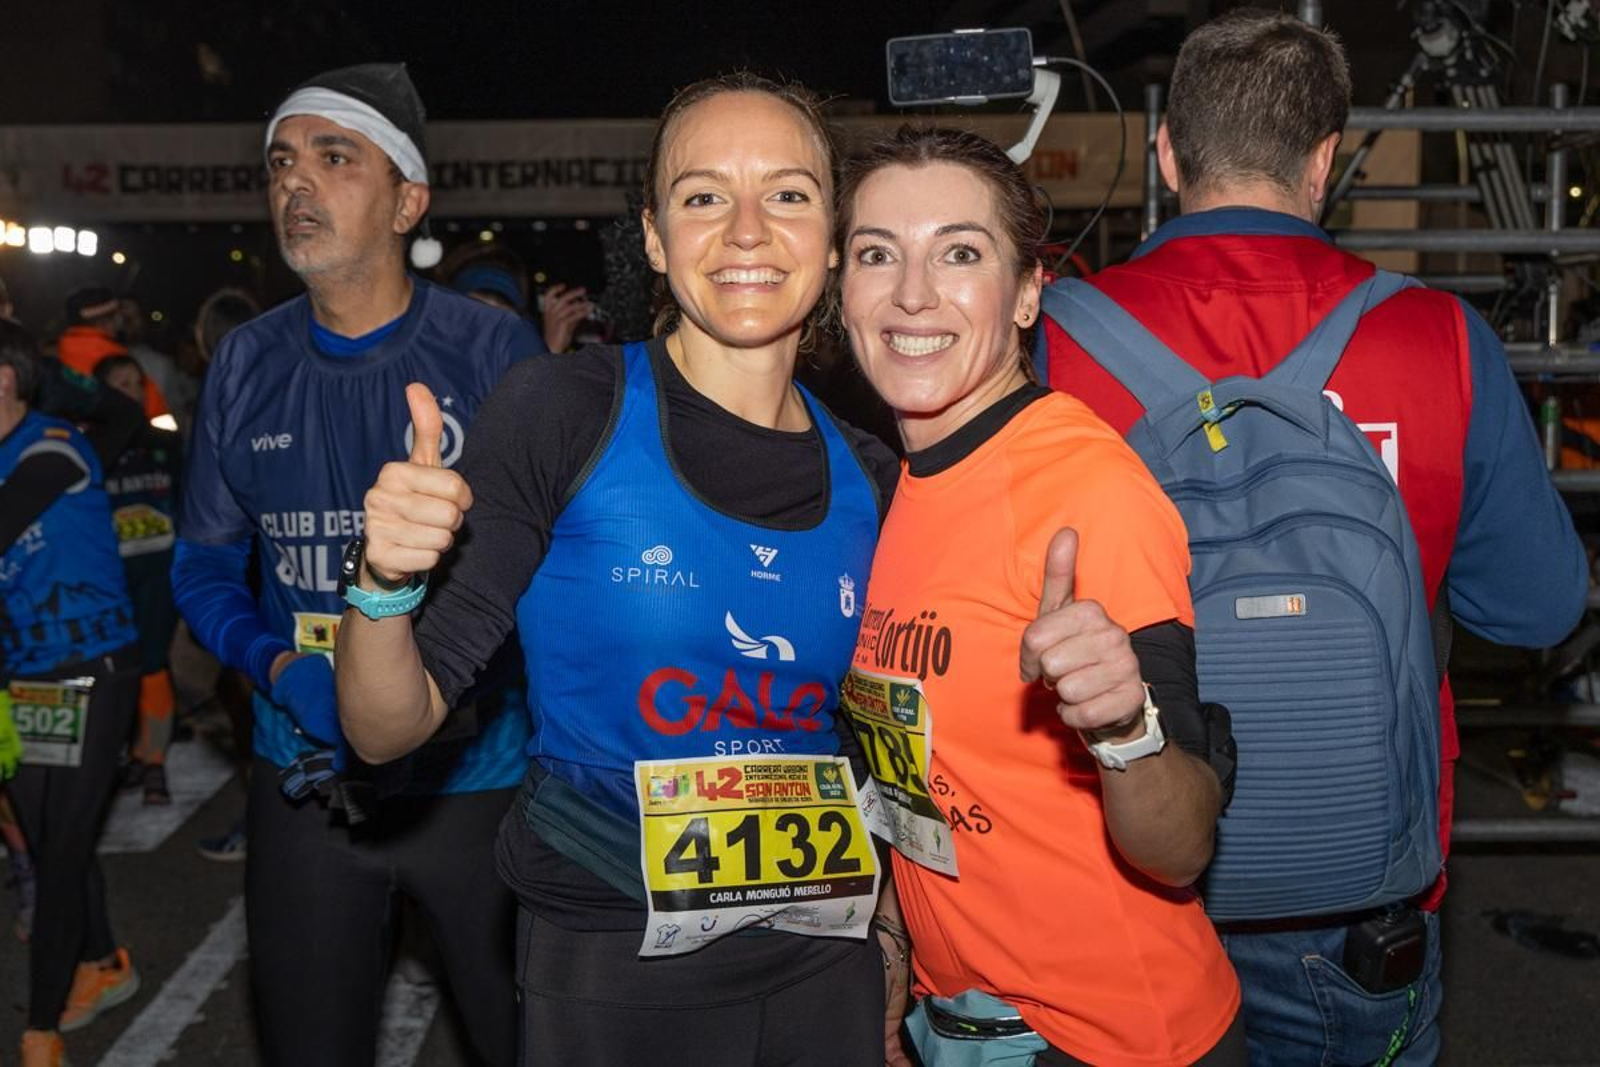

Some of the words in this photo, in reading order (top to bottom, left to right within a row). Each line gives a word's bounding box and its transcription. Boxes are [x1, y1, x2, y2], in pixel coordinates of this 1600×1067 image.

[251, 432, 292, 452] vive
[261, 511, 315, 538] CLUB
[611, 567, 699, 588] SPIRAL
[751, 569, 782, 582] HORME
[875, 608, 952, 682] Cortijo
[714, 738, 785, 757] SPORT
[695, 766, 744, 802] 42
[744, 782, 772, 798] SAN
[664, 810, 861, 883] 4132
[709, 890, 743, 904] CARLA
[746, 884, 791, 901] MONGUIÓ
[793, 883, 832, 898] MERELLO
